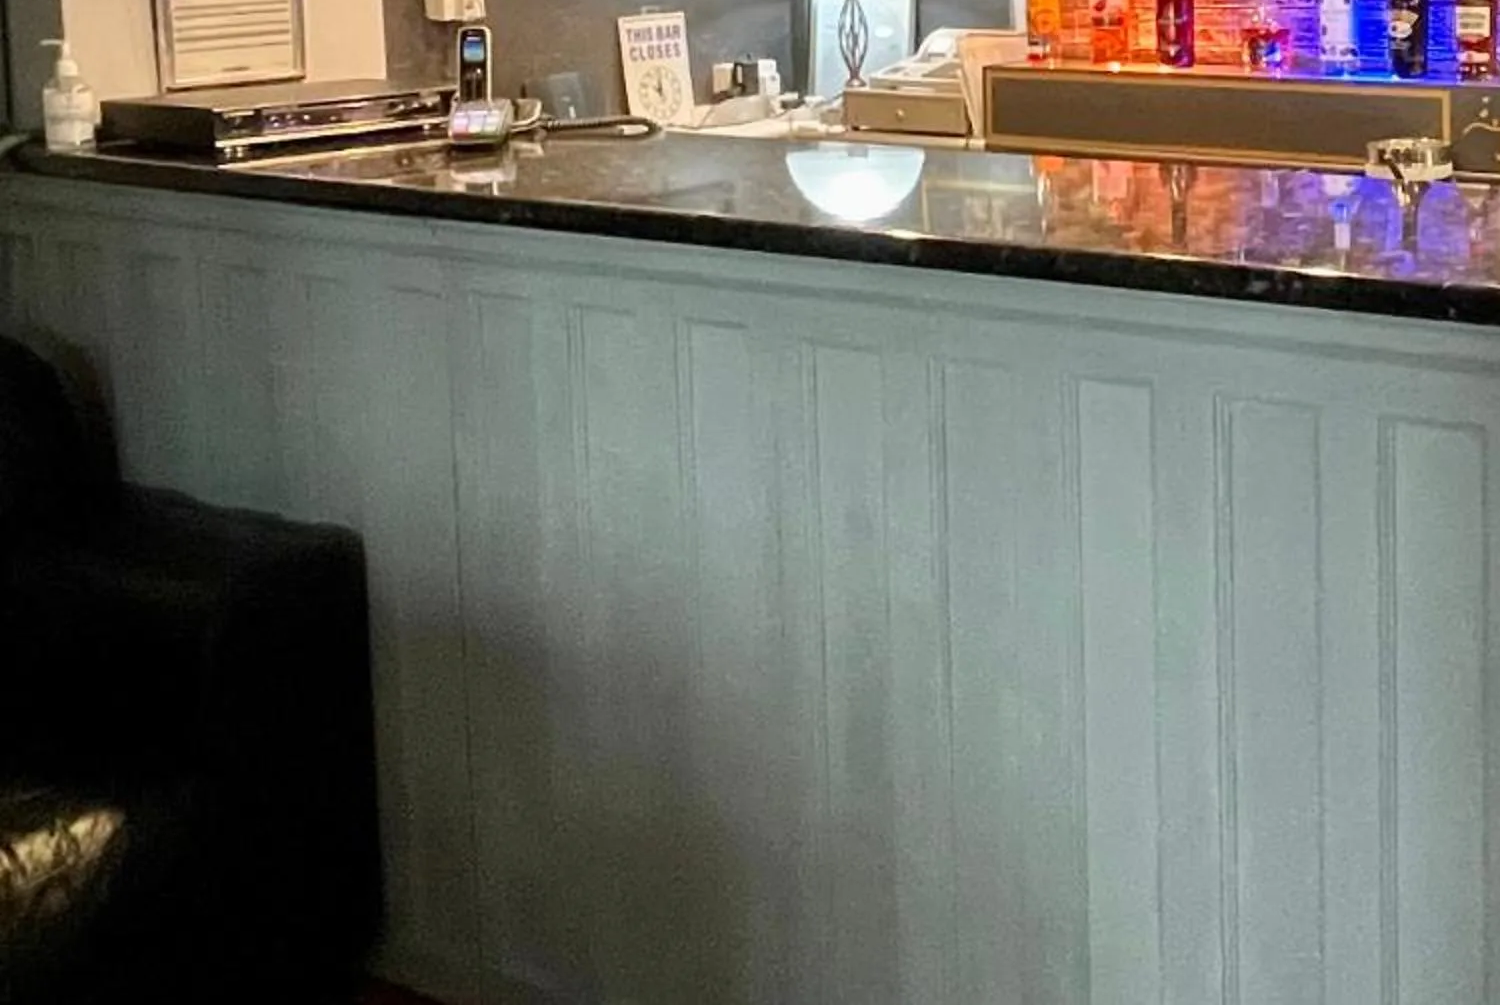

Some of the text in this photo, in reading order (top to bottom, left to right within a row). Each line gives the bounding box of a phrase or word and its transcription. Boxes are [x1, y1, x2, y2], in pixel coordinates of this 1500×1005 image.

[626, 24, 681, 43] THIS BAR
[629, 42, 682, 62] CLOSES
